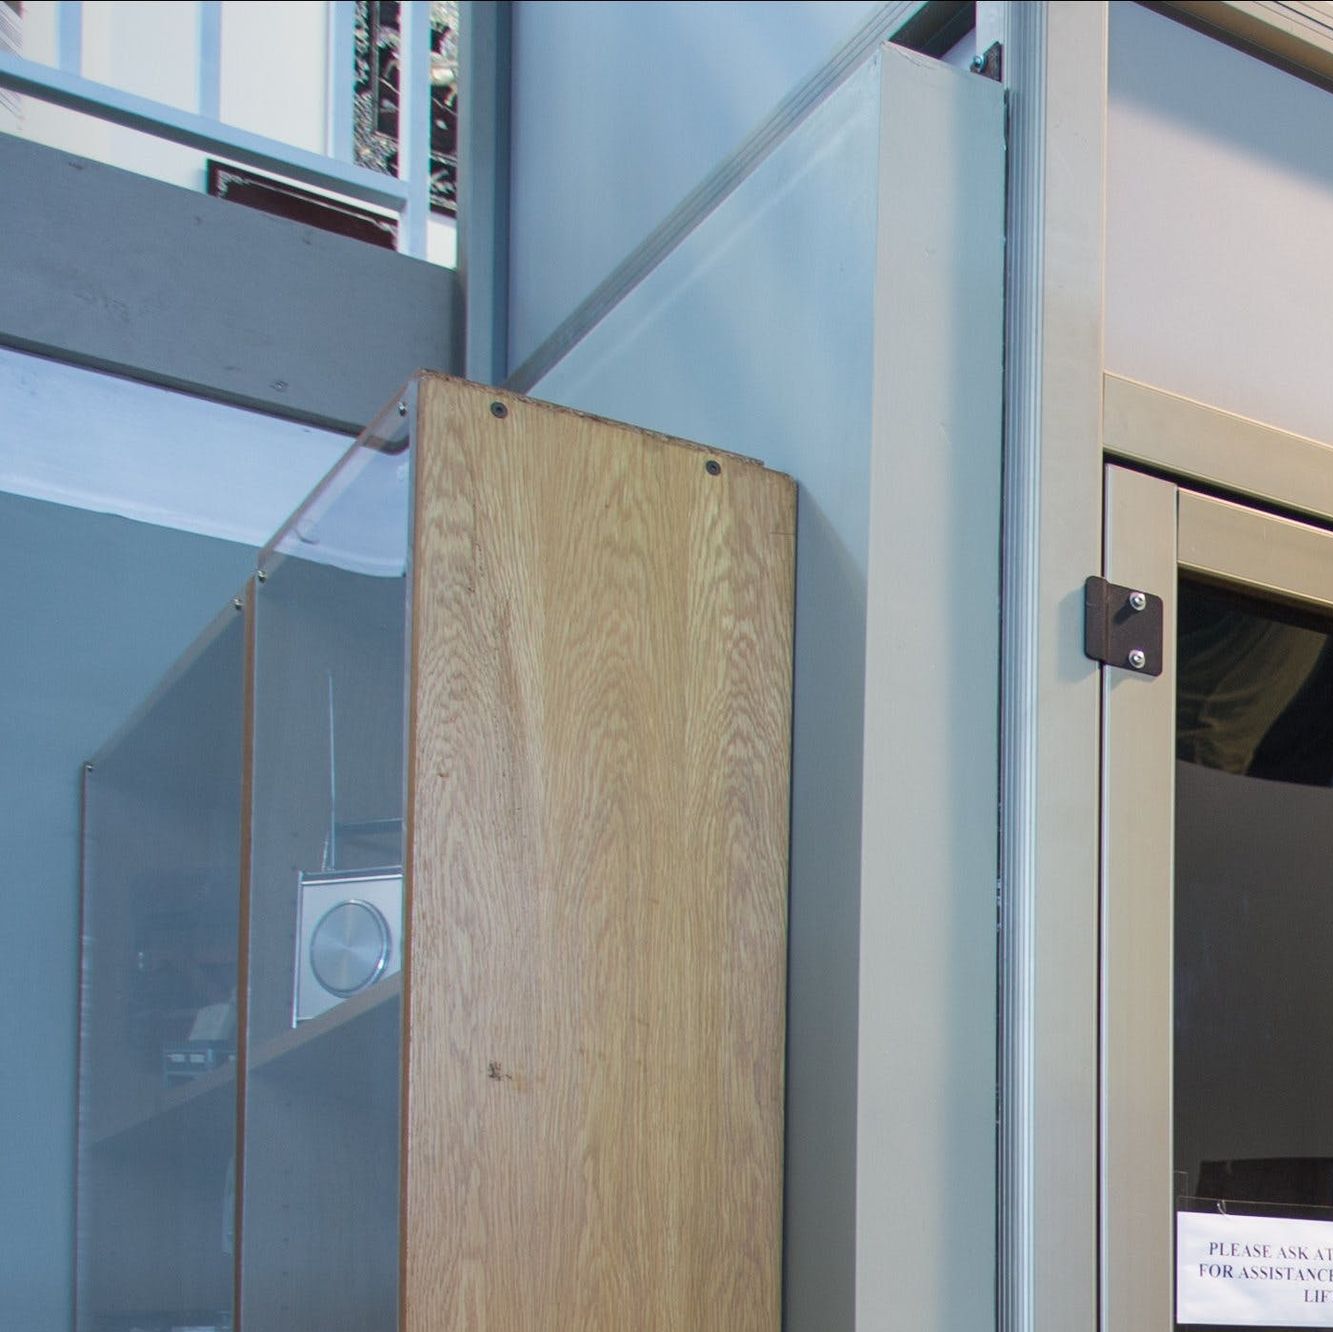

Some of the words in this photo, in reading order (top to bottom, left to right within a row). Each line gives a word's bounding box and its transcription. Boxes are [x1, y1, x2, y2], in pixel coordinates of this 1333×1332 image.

[1209, 1242, 1272, 1258] PLEASE
[1278, 1247, 1309, 1260] ASK
[1199, 1263, 1234, 1279] FOR
